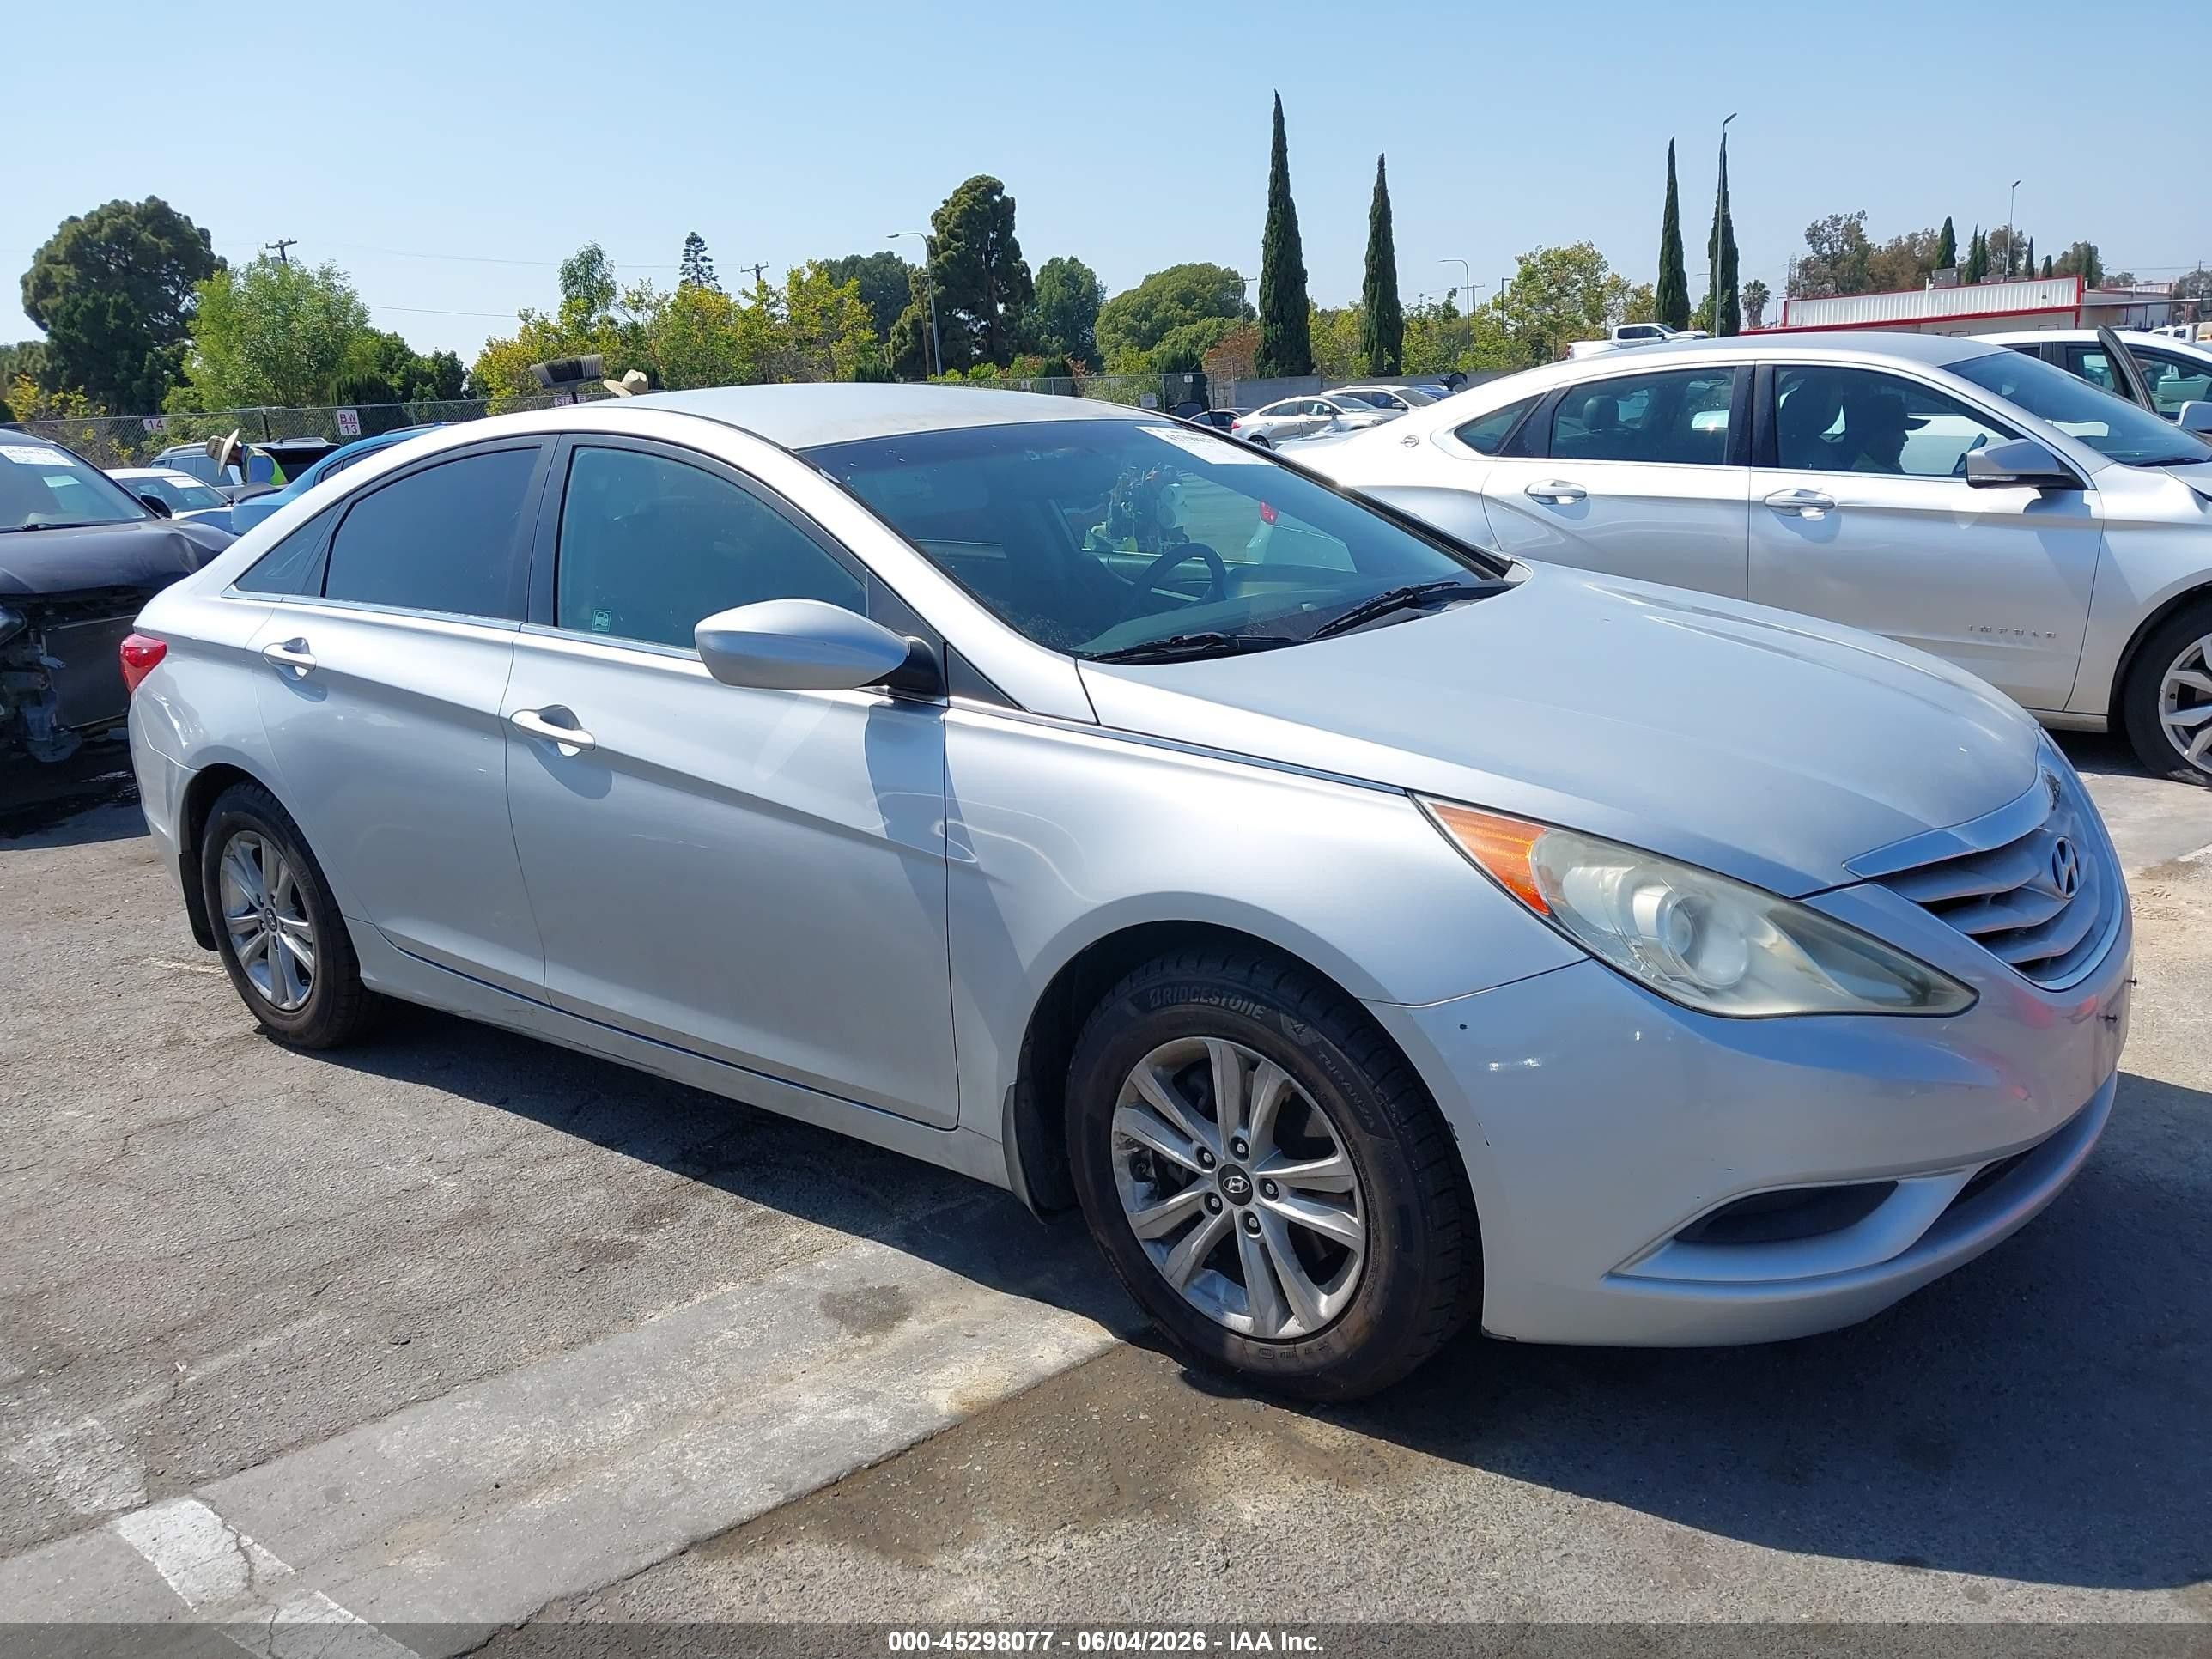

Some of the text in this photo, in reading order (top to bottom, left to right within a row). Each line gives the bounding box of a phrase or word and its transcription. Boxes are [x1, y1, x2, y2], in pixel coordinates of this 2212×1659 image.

[556, 396, 585, 406] STAE
[339, 413, 356, 422] BW
[148, 419, 164, 431] 14
[343, 425, 358, 434] 13
[1148, 986, 1267, 1020] BRIDGESTONE
